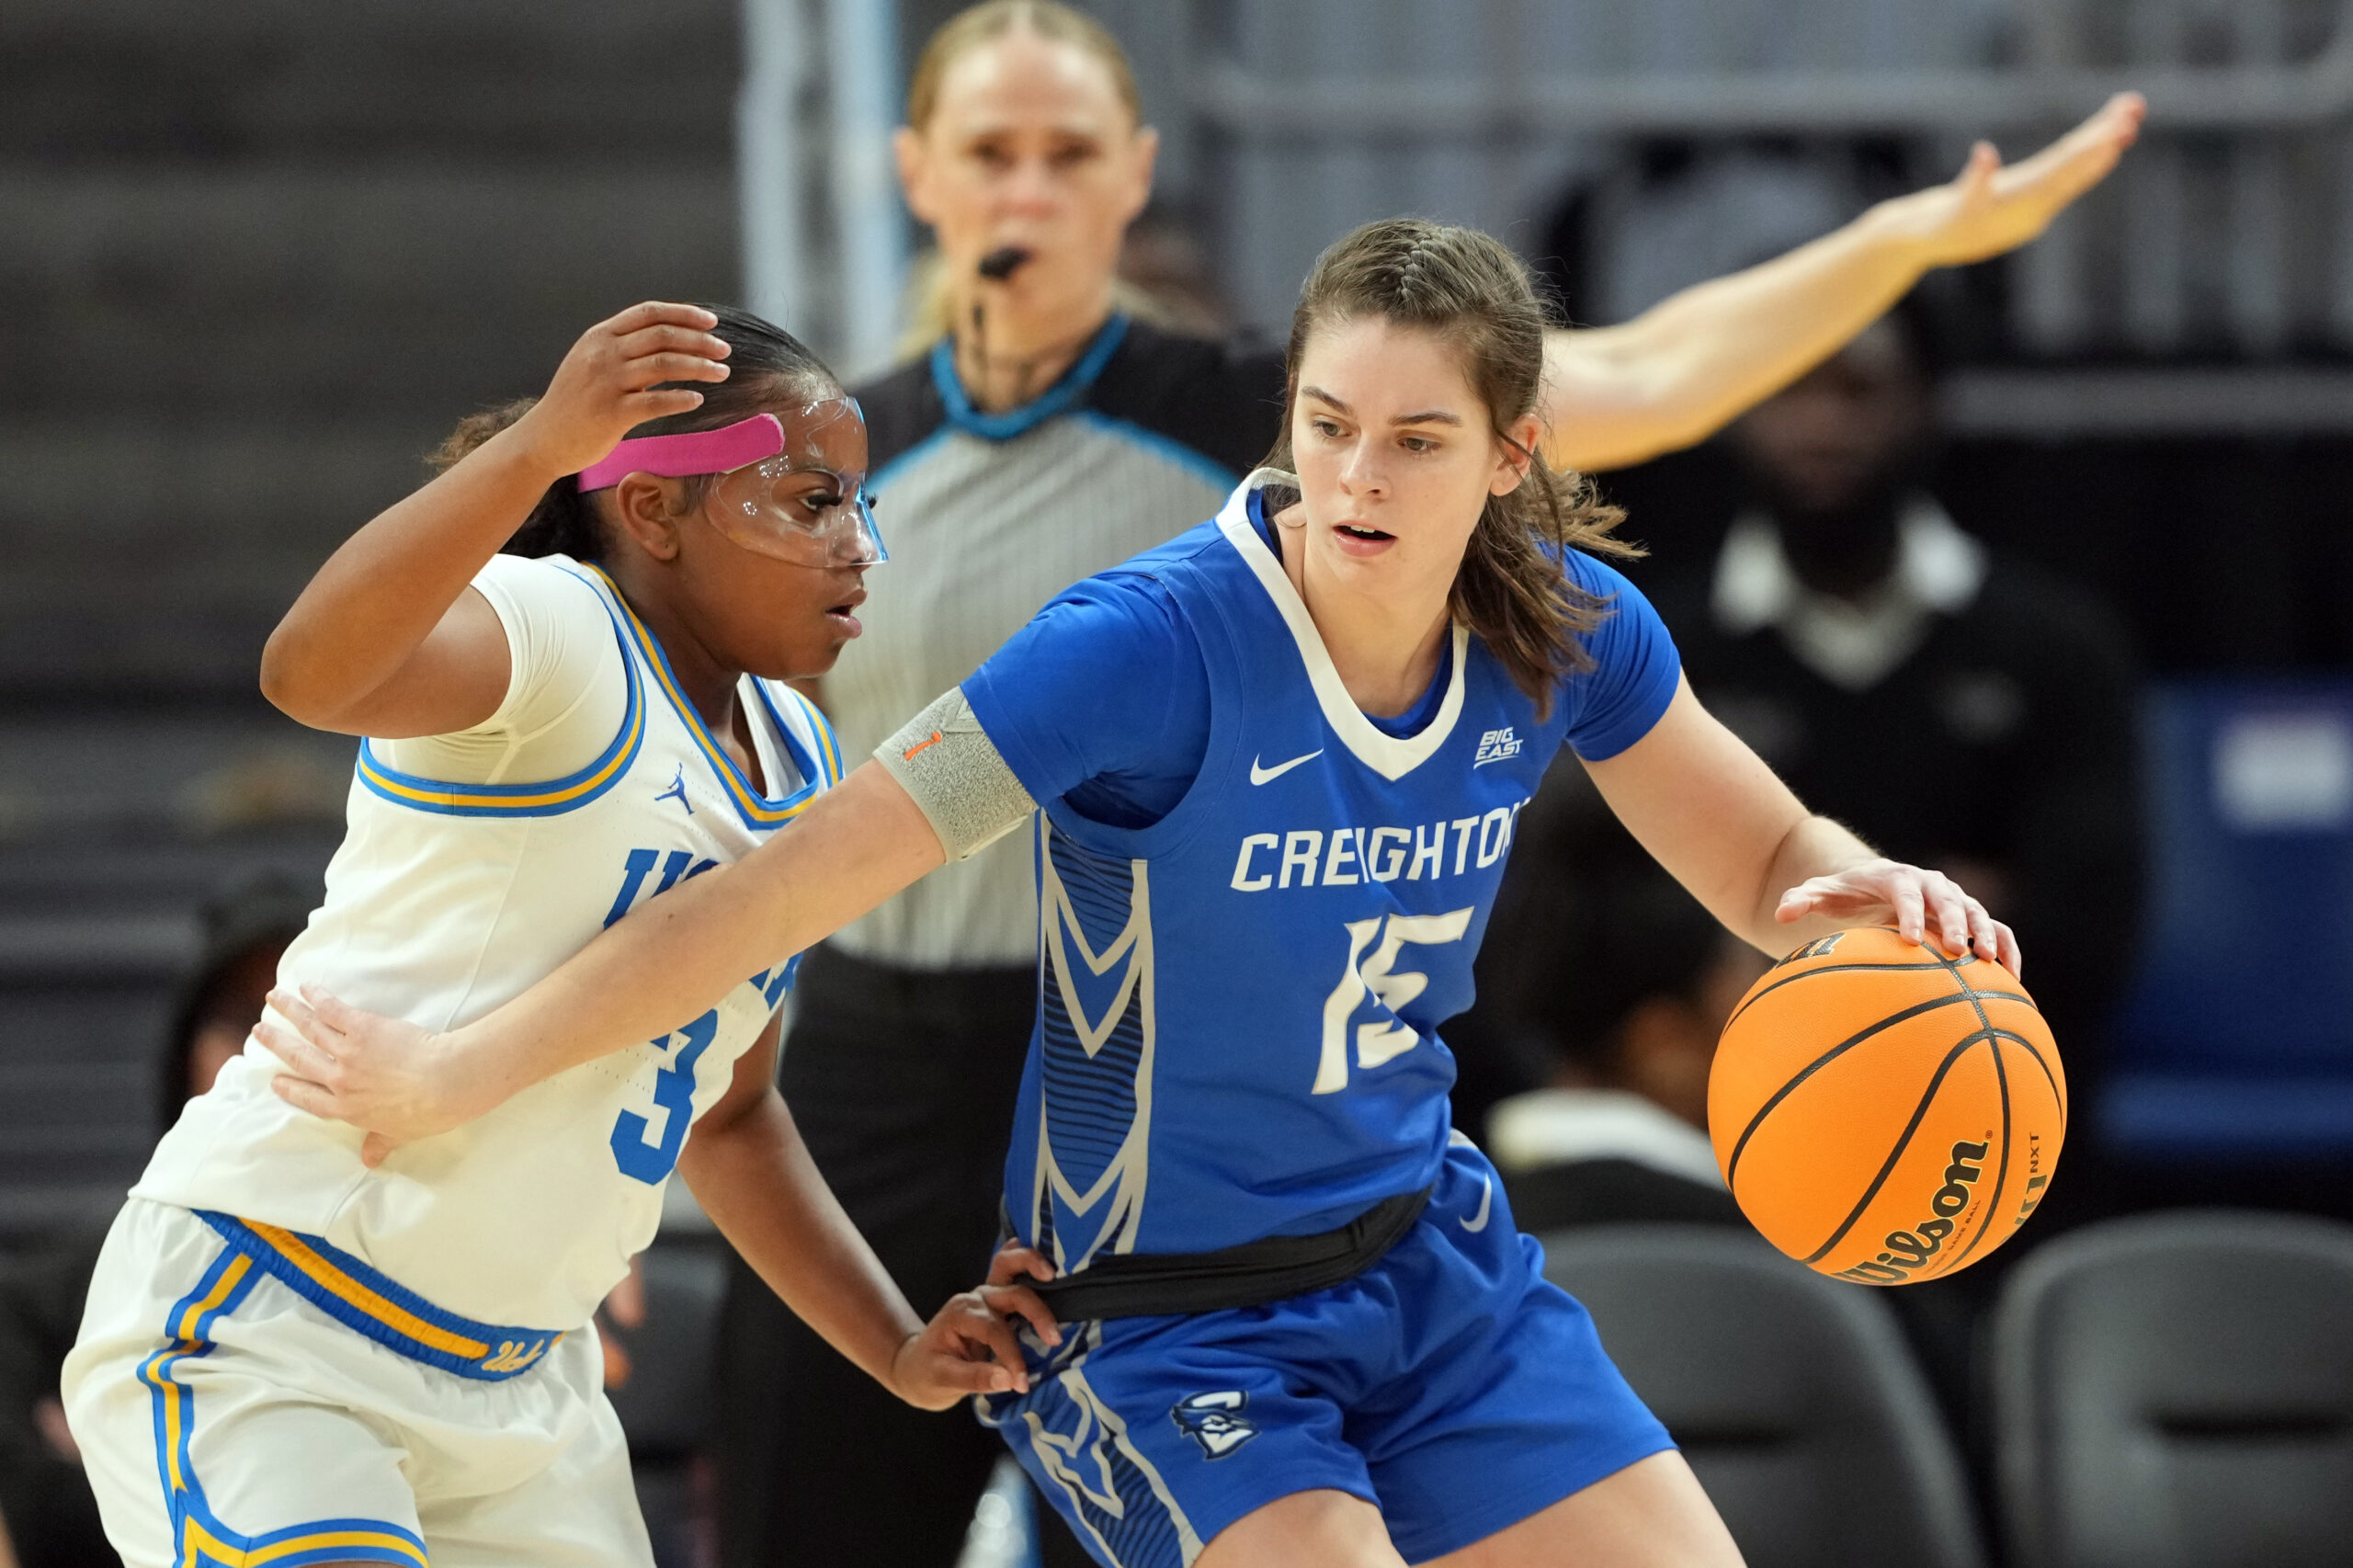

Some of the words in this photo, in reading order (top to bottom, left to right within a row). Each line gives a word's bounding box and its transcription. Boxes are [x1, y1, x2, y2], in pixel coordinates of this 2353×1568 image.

[1474, 739, 1524, 761] EAST
[1480, 726, 1514, 746] BIG
[1311, 905, 1475, 1095] 15
[609, 1008, 719, 1186] 3
[2029, 1131, 2040, 1174] NXT
[1829, 1139, 1991, 1286] Wilson
[1964, 1199, 1982, 1224] BALL
